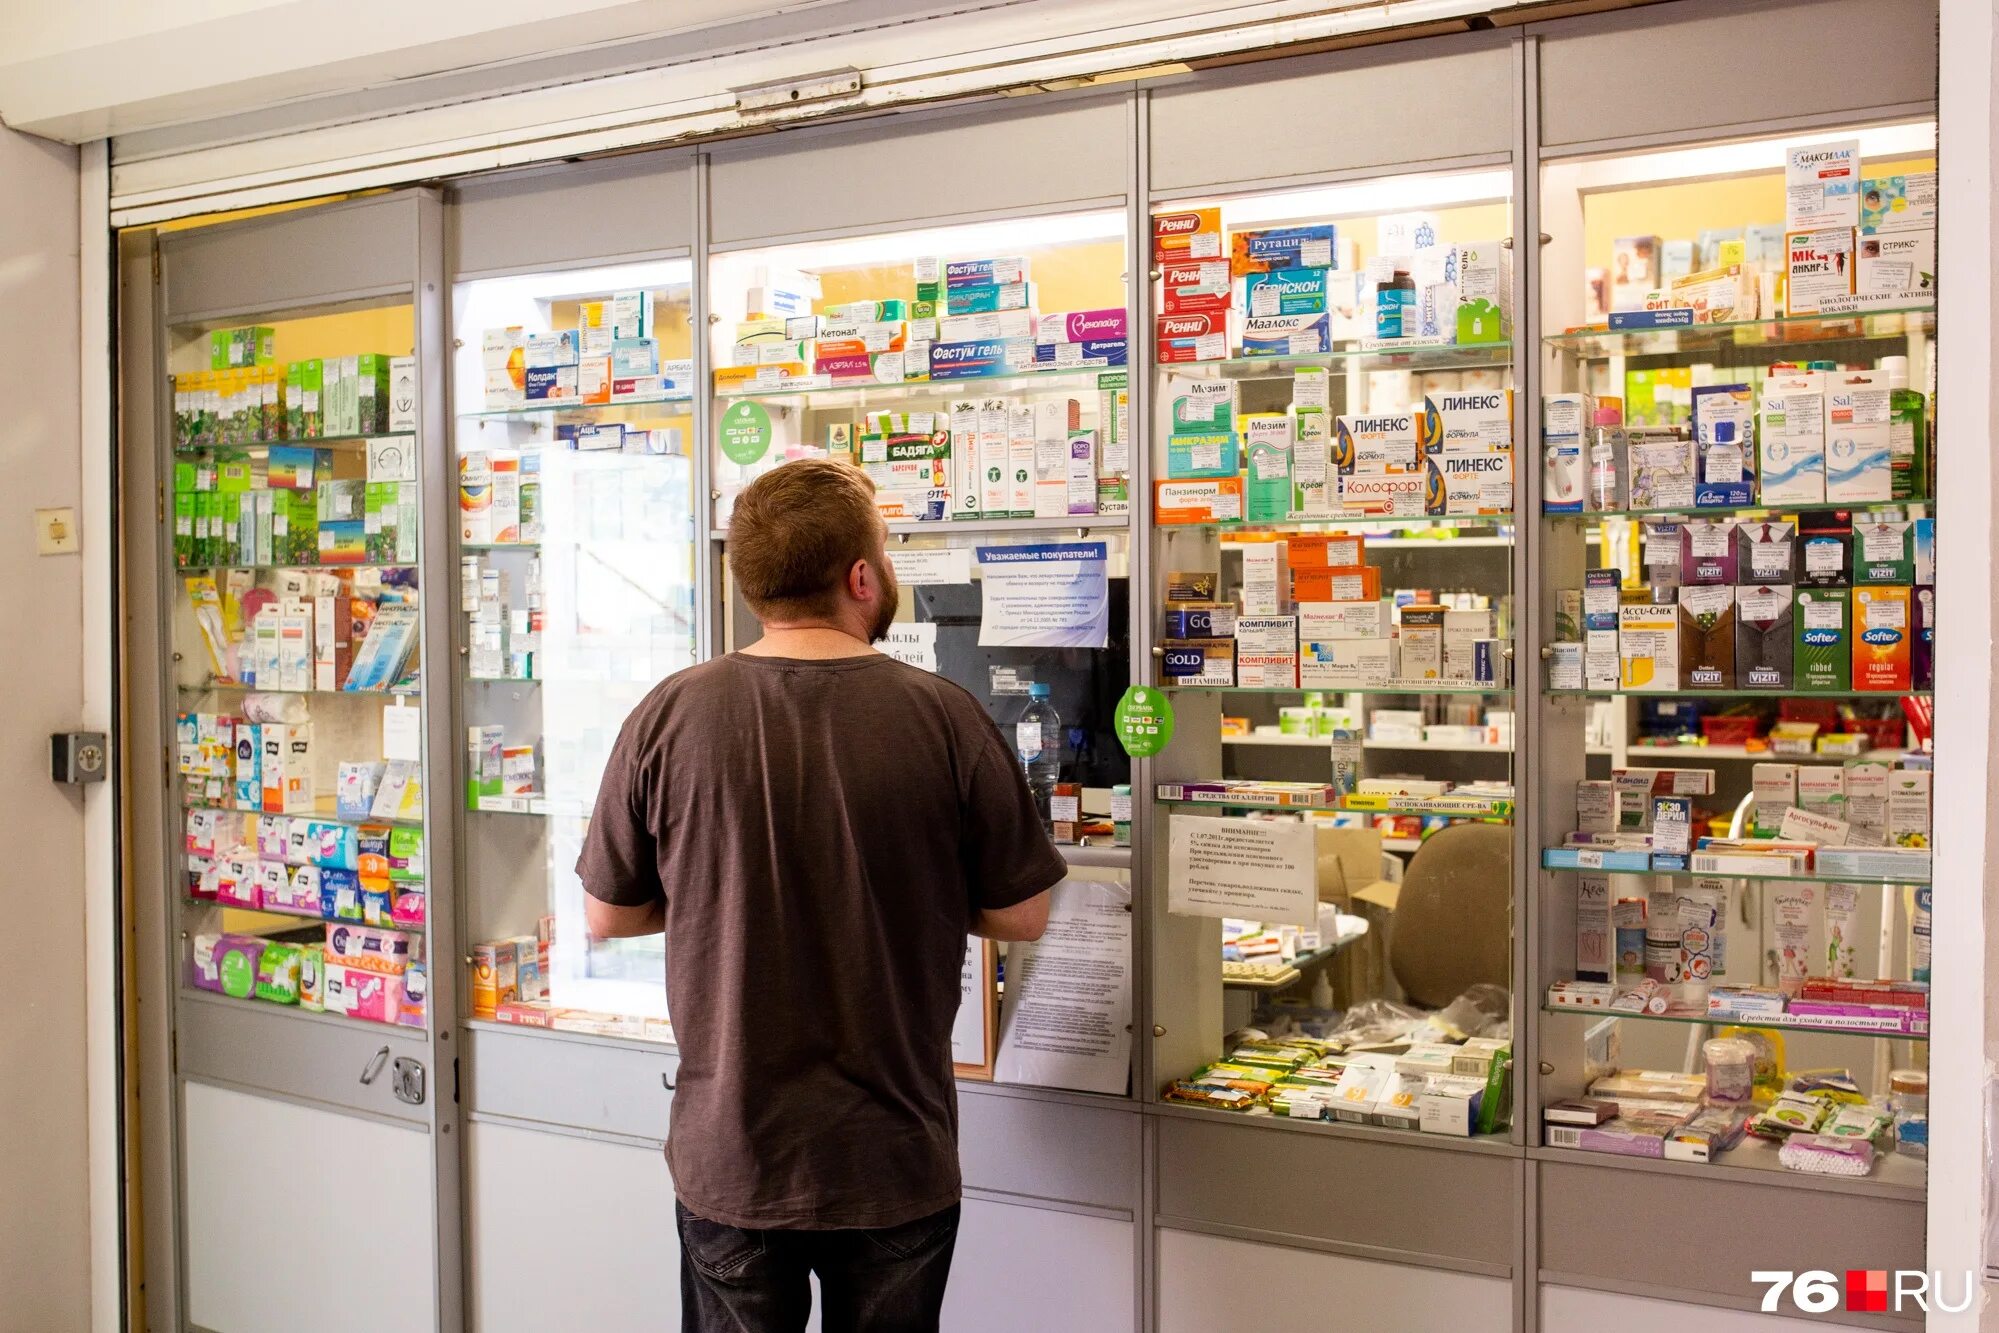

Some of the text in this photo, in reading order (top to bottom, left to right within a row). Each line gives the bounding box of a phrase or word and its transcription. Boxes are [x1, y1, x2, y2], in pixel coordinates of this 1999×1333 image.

[1801, 150, 1851, 163] МАКСИЛАК
[1159, 219, 1195, 233] Ренни
[1254, 237, 1309, 251] Рутаци
[1882, 240, 1915, 250] СТРИКС
[948, 262, 993, 275] Фастум гел
[1792, 262, 1829, 274] АНКИР-Б
[1170, 269, 1201, 283] Ренн
[1819, 290, 1934, 306] БИОЛОГИЧЕСКИЕ АКТИВН
[1820, 305, 1858, 314] ДОБАВКИ
[1072, 314, 1121, 338] Венолайф
[1164, 320, 1204, 334] Ренни
[1246, 319, 1299, 330] Маалокс
[821, 328, 857, 338] Кетонал
[1091, 342, 1126, 350] Детрагель
[1365, 341, 1399, 349] Средства
[933, 345, 1003, 361] Фастум гель
[829, 360, 853, 369] АЭРТАЛ
[1020, 361, 1073, 369] АНТИВАРИКОЗНЫЕ
[1192, 384, 1227, 394] Мезим
[1442, 395, 1500, 411] ЛИНЕКС
[1767, 401, 1785, 411] Sal
[1832, 396, 1851, 406] Sal
[1252, 422, 1286, 430] Мезим
[1354, 418, 1409, 433] ЛИНЕКС
[893, 445, 934, 457] БАДЯГА
[1445, 458, 1503, 473] ЛИНЕКС
[1300, 482, 1324, 490] Креон
[1347, 481, 1424, 495] Колофорт
[1165, 488, 1216, 496] Панзинорм
[985, 549, 1098, 561] Уважаемые покупатели!
[1190, 614, 1212, 628] GO
[1239, 620, 1294, 628] КОМПЛИВИТ
[1805, 633, 1837, 643] Softex
[1865, 632, 1898, 642] Softex
[1165, 653, 1201, 665] GOLD
[1239, 656, 1293, 664] КОМПЛИВИТ
[1810, 662, 1832, 672] ribbed
[1869, 662, 1894, 673] regular
[1181, 677, 1230, 685] ВИТАМИНЫ
[1387, 679, 1459, 687] ВЕНОТОНИЗИРУЮЩИЕ
[1336, 762, 1348, 786] Зир
[1616, 777, 1649, 785] Кандид
[1240, 794, 1275, 802] АЛЛЕРГИИ
[1395, 801, 1461, 809] УСПОКАИВАЮЩИЕ
[1657, 802, 1681, 812] ЭКЗО
[1656, 811, 1685, 821] ДЕРИЛ
[1788, 811, 1838, 832] Аргосульфан
[1741, 1013, 1781, 1023] Средства
[1782, 1014, 1797, 1023] для
[1800, 1015, 1822, 1025] ухода
[1835, 1018, 1878, 1027] полостью
[1879, 1020, 1898, 1029] рта
